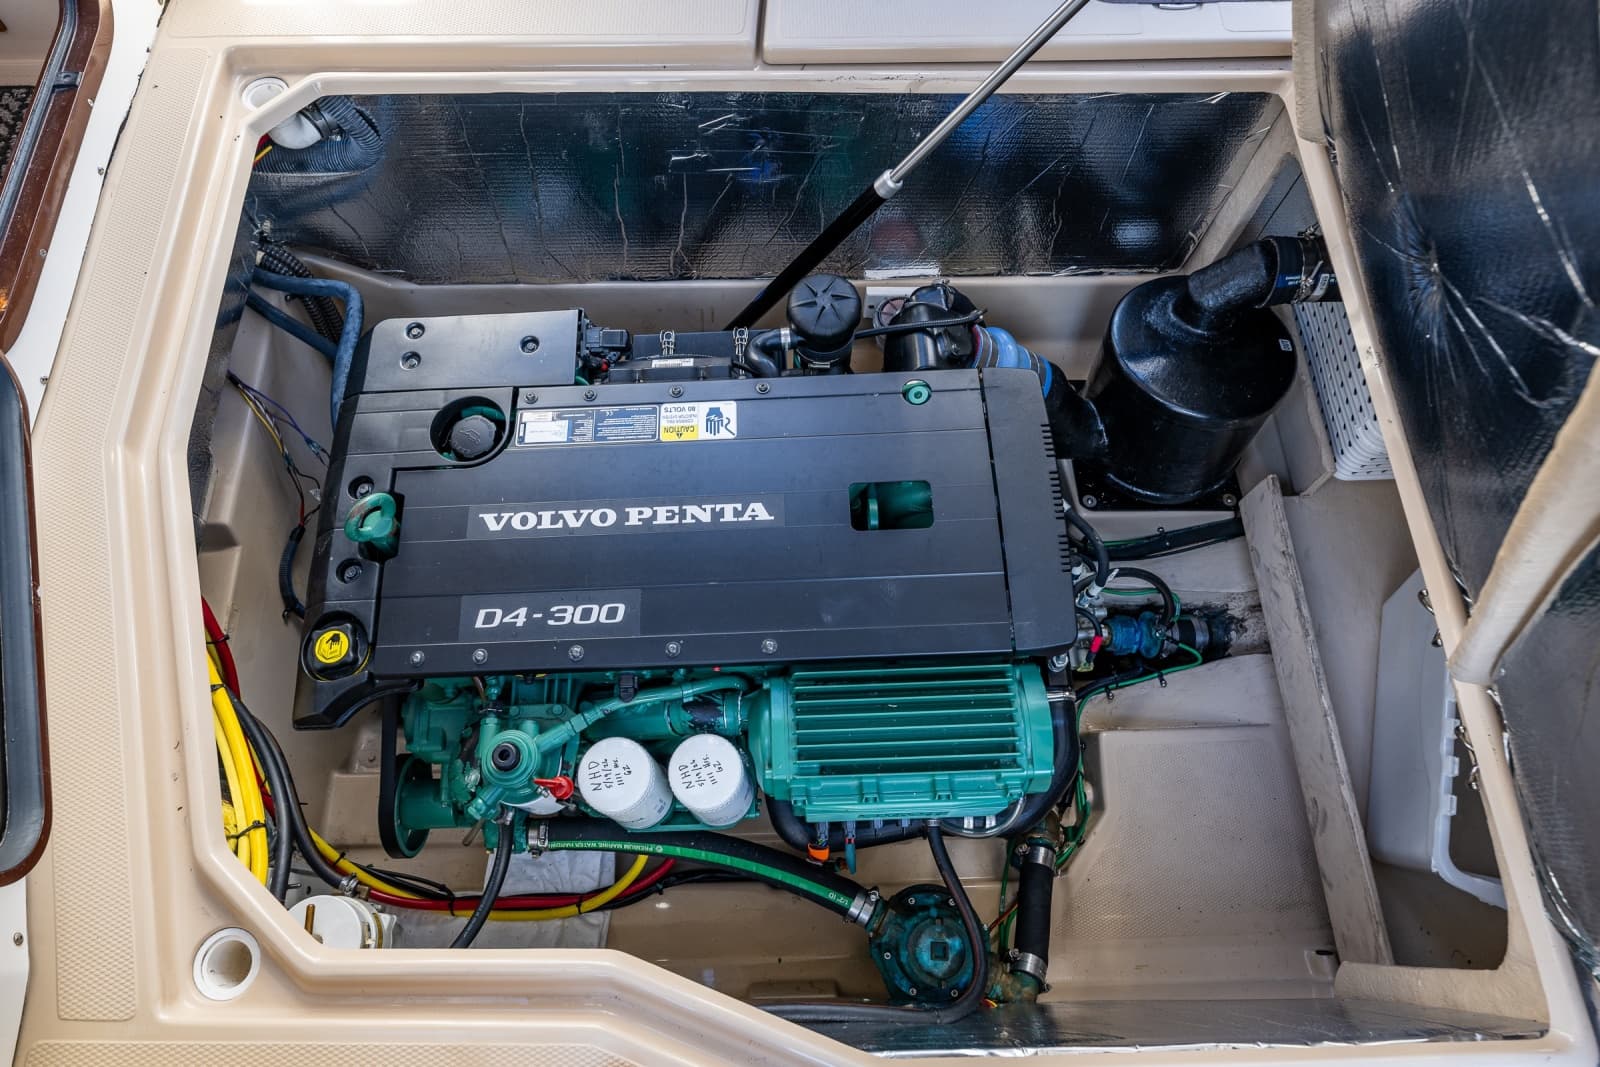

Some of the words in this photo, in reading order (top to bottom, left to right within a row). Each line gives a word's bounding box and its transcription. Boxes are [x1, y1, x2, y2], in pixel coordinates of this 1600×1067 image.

[663, 425, 695, 433] CAUTION
[479, 508, 617, 531] VOLVO
[623, 502, 774, 526] PENTA
[474, 603, 625, 629] D4-300
[575, 841, 599, 849] WATER
[624, 843, 654, 851] PREMIUM
